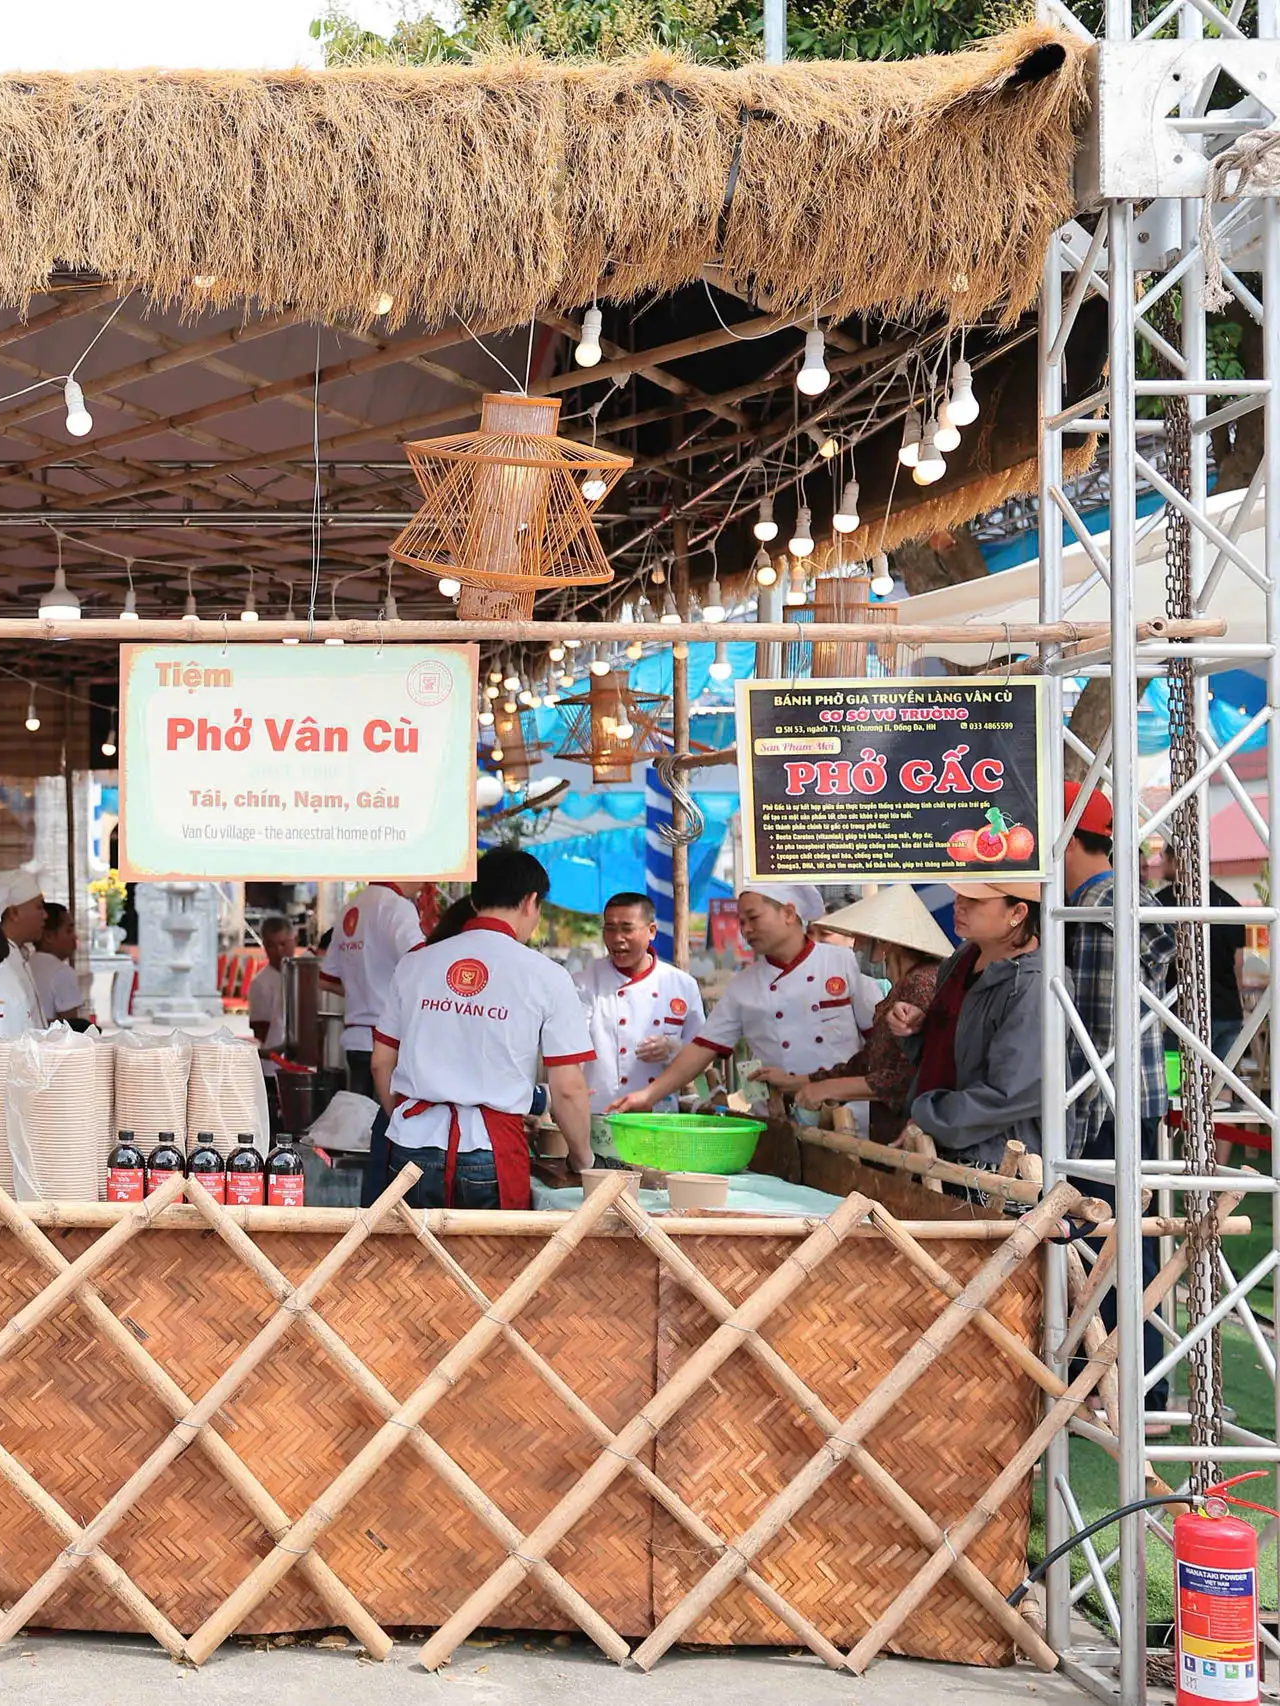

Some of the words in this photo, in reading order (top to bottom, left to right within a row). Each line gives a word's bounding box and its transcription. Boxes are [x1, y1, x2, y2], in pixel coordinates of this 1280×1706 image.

[154, 661, 233, 695] Tiệm
[774, 693, 811, 706] BÁNH
[815, 692, 843, 705] PHỞ
[847, 694, 869, 704] GIA
[872, 689, 924, 703] TRUYỀN
[928, 690, 961, 703] LÀNG
[964, 690, 991, 702] VÂN
[995, 690, 1012, 702] CÙ
[819, 709, 844, 722] CƠ
[969, 722, 982, 730] 033
[984, 722, 1013, 730] 4865599
[166, 708, 253, 751] Phở
[264, 716, 348, 752] Vân
[363, 717, 419, 754] Cù
[784, 748, 887, 795] PHỞ
[899, 744, 1005, 794] GẤC
[189, 789, 227, 810] Tái,
[234, 789, 287, 811] chín,
[294, 791, 349, 813] Nạm,
[357, 787, 399, 808] Gầu
[182, 825, 202, 839] Van
[205, 824, 218, 839] Cu
[220, 824, 255, 841] village
[265, 825, 282, 839] the
[286, 826, 335, 840] ancestral
[338, 825, 368, 840] home
[371, 826, 382, 840] of
[385, 826, 406, 840] Pho
[421, 997, 453, 1012] PHỞ
[455, 1001, 484, 1016] VÂN
[487, 1007, 508, 1020] CÙ
